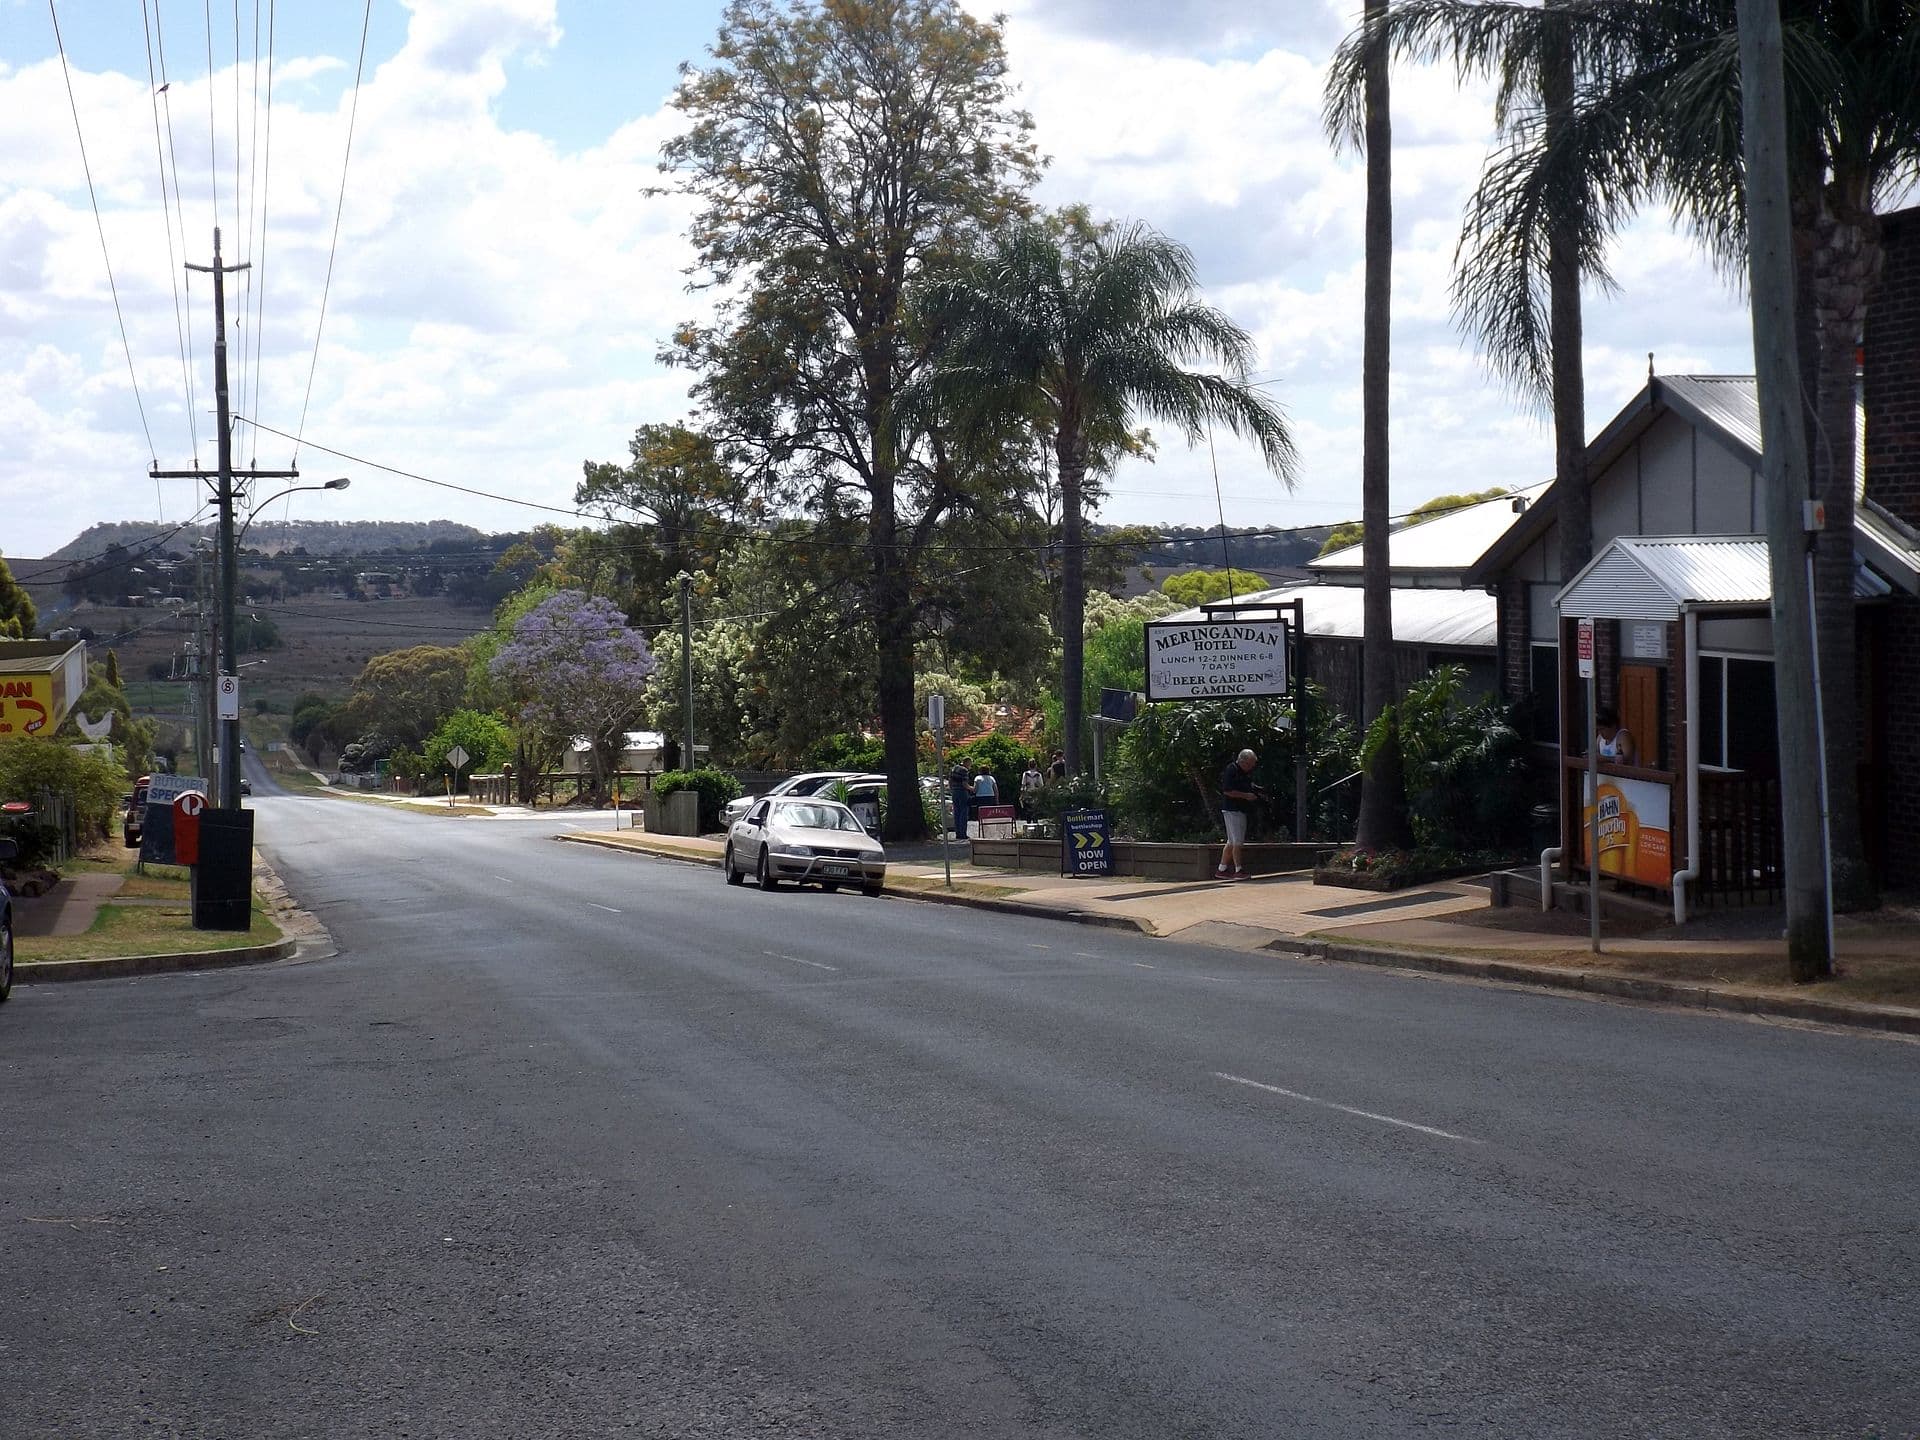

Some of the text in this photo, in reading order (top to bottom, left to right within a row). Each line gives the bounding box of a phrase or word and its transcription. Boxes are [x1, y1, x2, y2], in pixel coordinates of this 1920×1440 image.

[1155, 627, 1279, 651] MERINGANDAN
[1194, 640, 1237, 651] HOTEL
[1161, 656, 1195, 664] LUNCH
[1220, 654, 1257, 662] DINNER
[1259, 652, 1273, 660] 6-8
[1209, 662, 1236, 670] DAYS
[1172, 673, 1264, 686] BEER GARDEN
[0, 681, 32, 698] AN
[1191, 684, 1245, 695] GAMING
[154, 776, 204, 789] BUTCHER
[1078, 850, 1104, 859] NOW
[1079, 861, 1108, 871] OPEN
